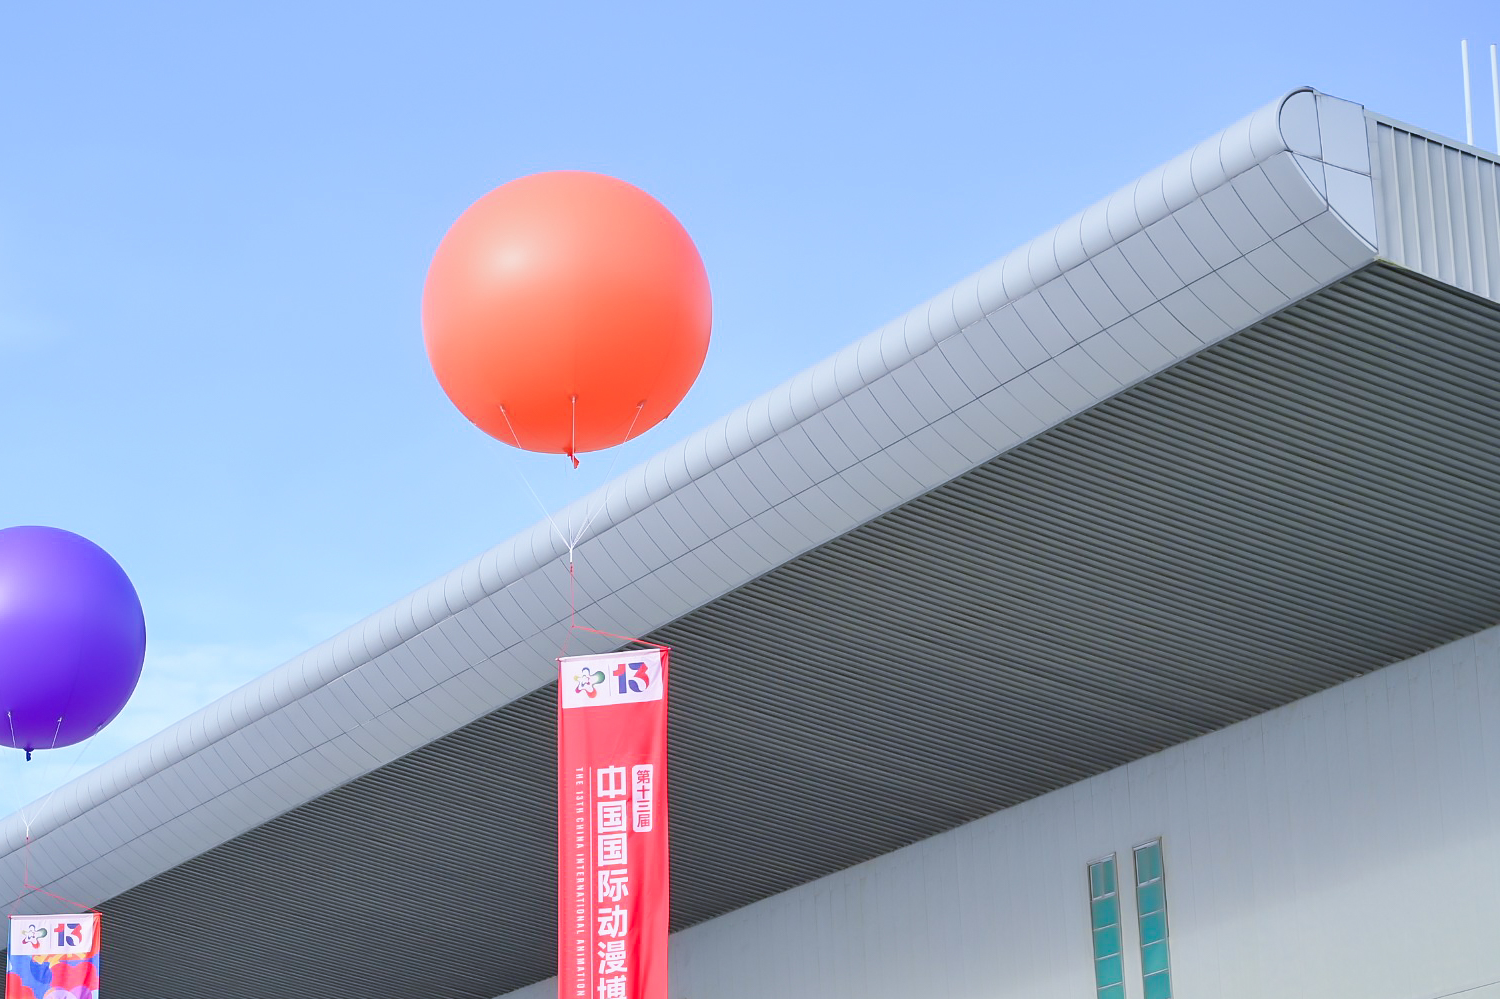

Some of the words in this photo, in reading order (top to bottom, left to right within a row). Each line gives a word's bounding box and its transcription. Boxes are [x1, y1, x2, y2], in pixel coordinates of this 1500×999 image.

[612, 661, 650, 694] 13
[575, 767, 584, 785] THE
[575, 790, 584, 814] 13TH
[636, 769, 650, 828] 第十三届
[575, 817, 584, 849] CHINA
[575, 853, 585, 935] INTERNATIONAL
[576, 939, 586, 997] ANIMATION
